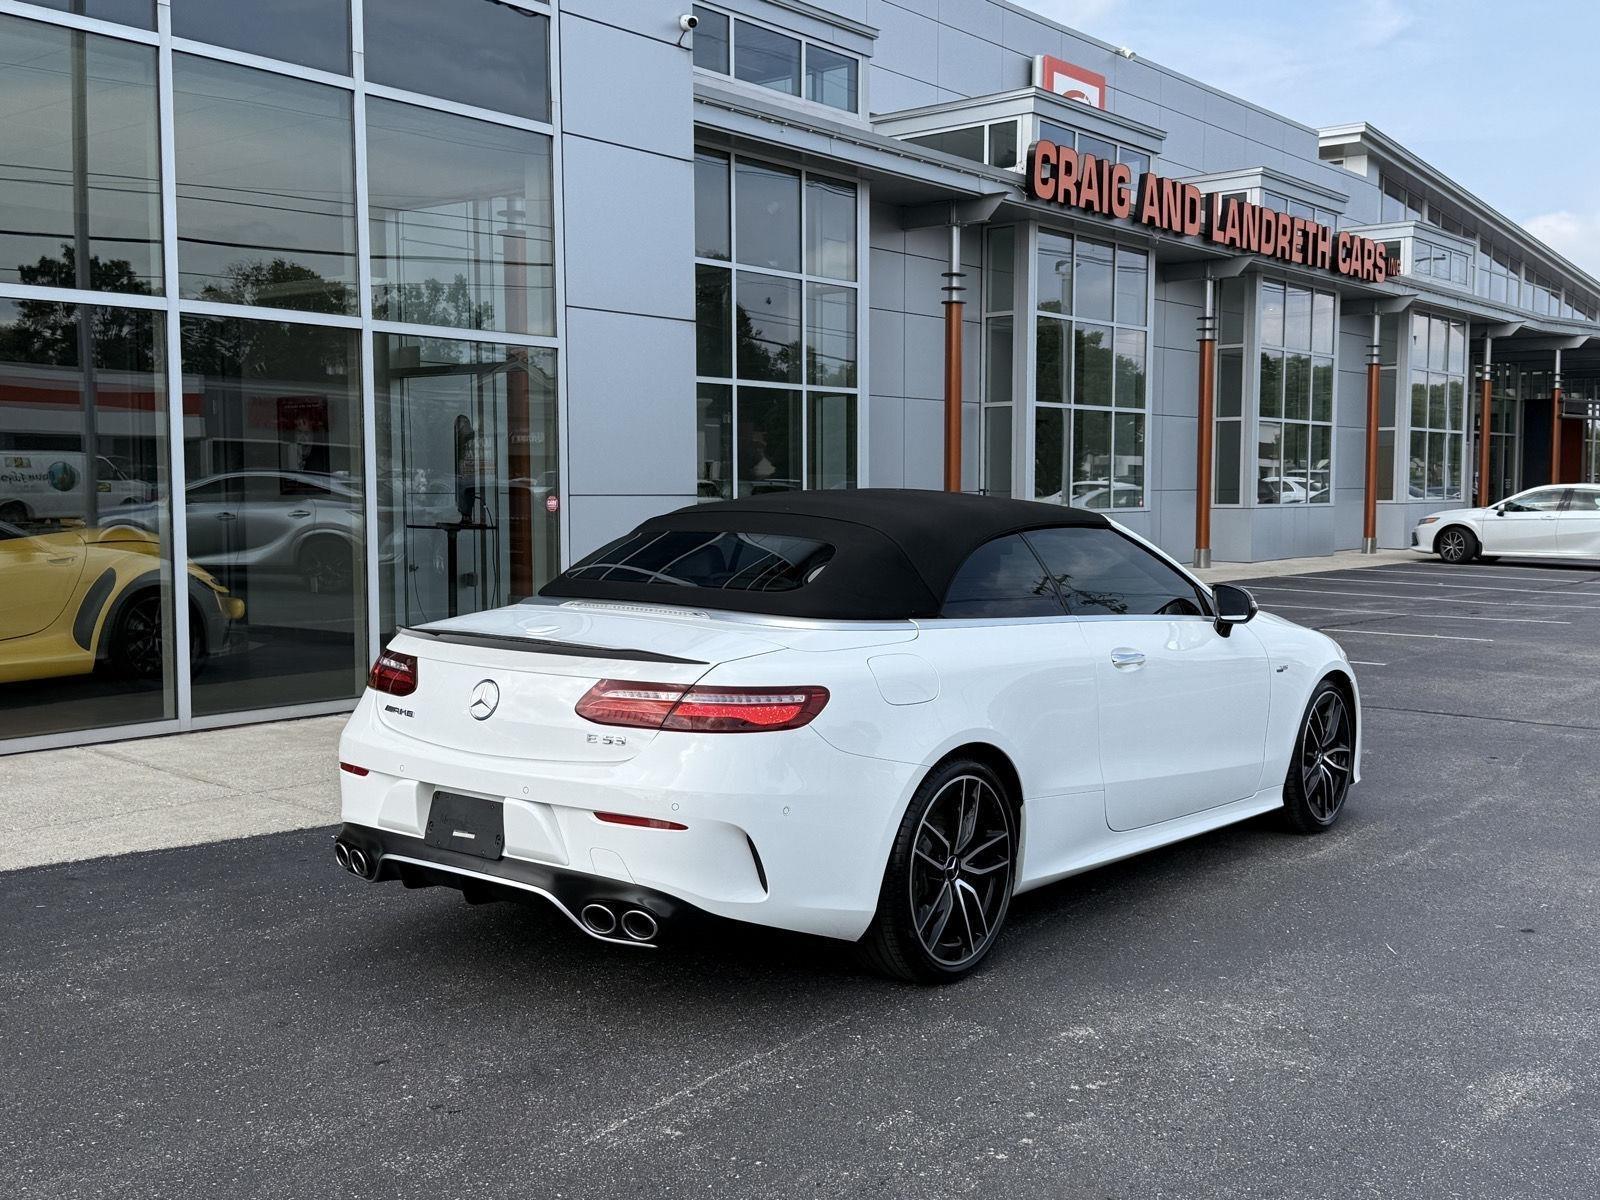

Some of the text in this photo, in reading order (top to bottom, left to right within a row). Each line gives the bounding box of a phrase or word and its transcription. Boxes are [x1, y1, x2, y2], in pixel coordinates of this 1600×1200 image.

[1032, 139, 1132, 219] CRAIG
[1140, 172, 1201, 237] AND
[1210, 192, 1332, 270] LANDRETH
[1336, 231, 1387, 283] CARS
[586, 733, 627, 746] E 53
